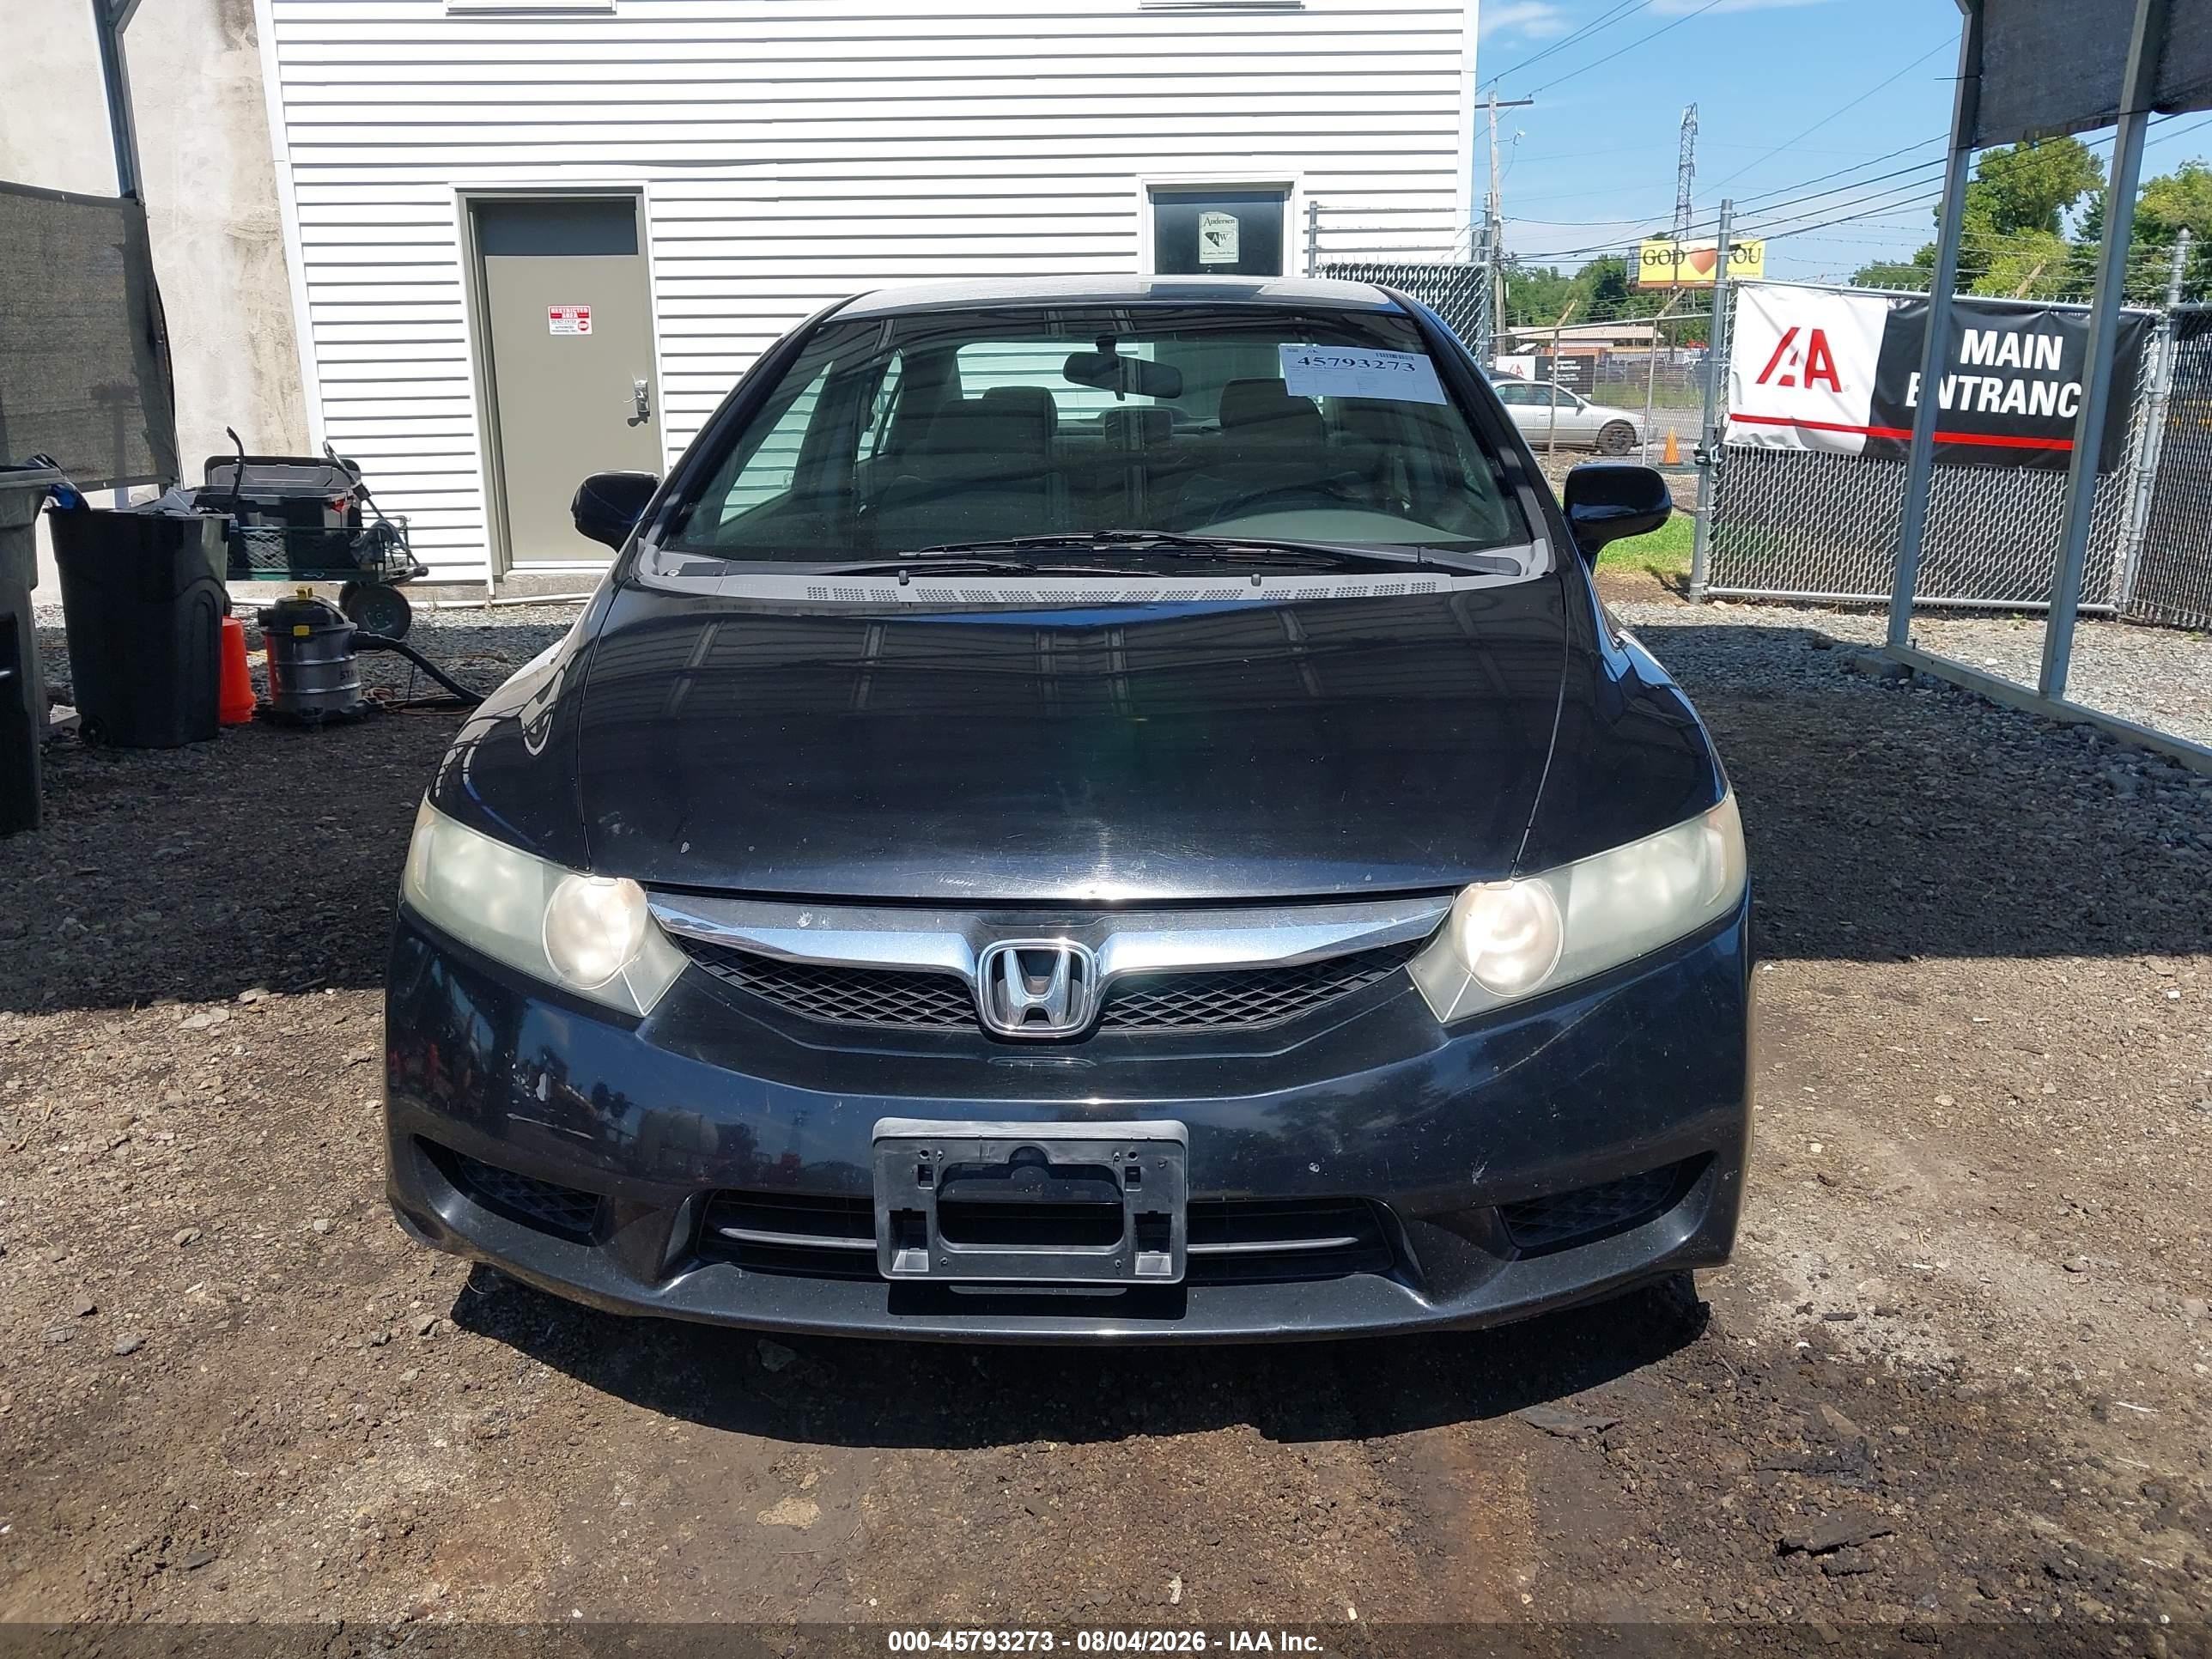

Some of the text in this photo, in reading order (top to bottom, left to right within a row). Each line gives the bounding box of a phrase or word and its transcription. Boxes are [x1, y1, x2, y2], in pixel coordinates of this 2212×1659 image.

[1204, 216, 1235, 227] Andersen
[1643, 247, 1762, 266] GOD OU
[1960, 329, 2063, 371] MAIN
[1297, 356, 1416, 372] 45793273
[1905, 372, 2082, 418] ENTRANC
